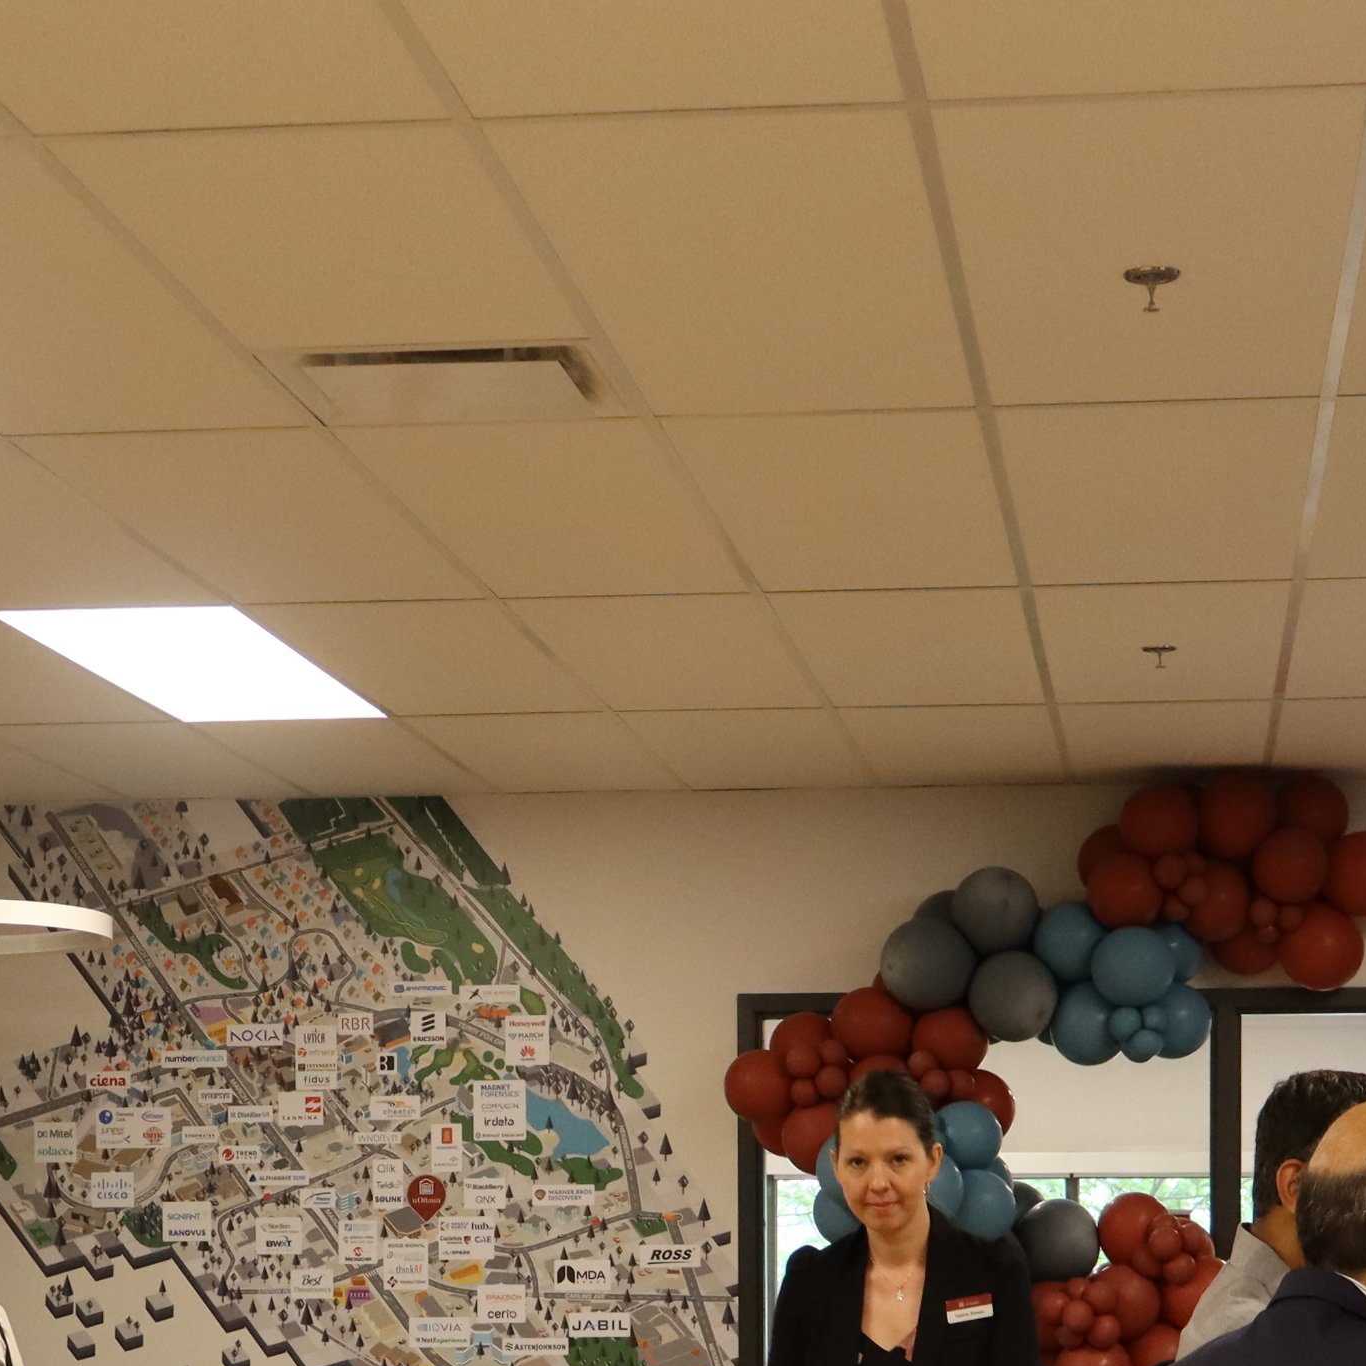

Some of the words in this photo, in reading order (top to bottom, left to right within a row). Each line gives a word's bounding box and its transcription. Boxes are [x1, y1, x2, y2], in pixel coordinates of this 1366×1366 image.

[341, 1018, 371, 1031] RBR
[509, 1020, 546, 1028] Honeywell
[230, 1029, 280, 1041] NOKIA
[90, 1074, 126, 1087] ciena
[304, 1074, 330, 1084] fidus
[484, 1116, 515, 1126] irdeto
[49, 1128, 73, 1138] Mitel
[475, 1196, 496, 1204] QNX
[650, 1249, 692, 1260] ROSS
[395, 1264, 423, 1274] thinkRF
[576, 1270, 606, 1280] MDA
[301, 1274, 323, 1287] Best
[572, 1320, 628, 1331] JABIL
